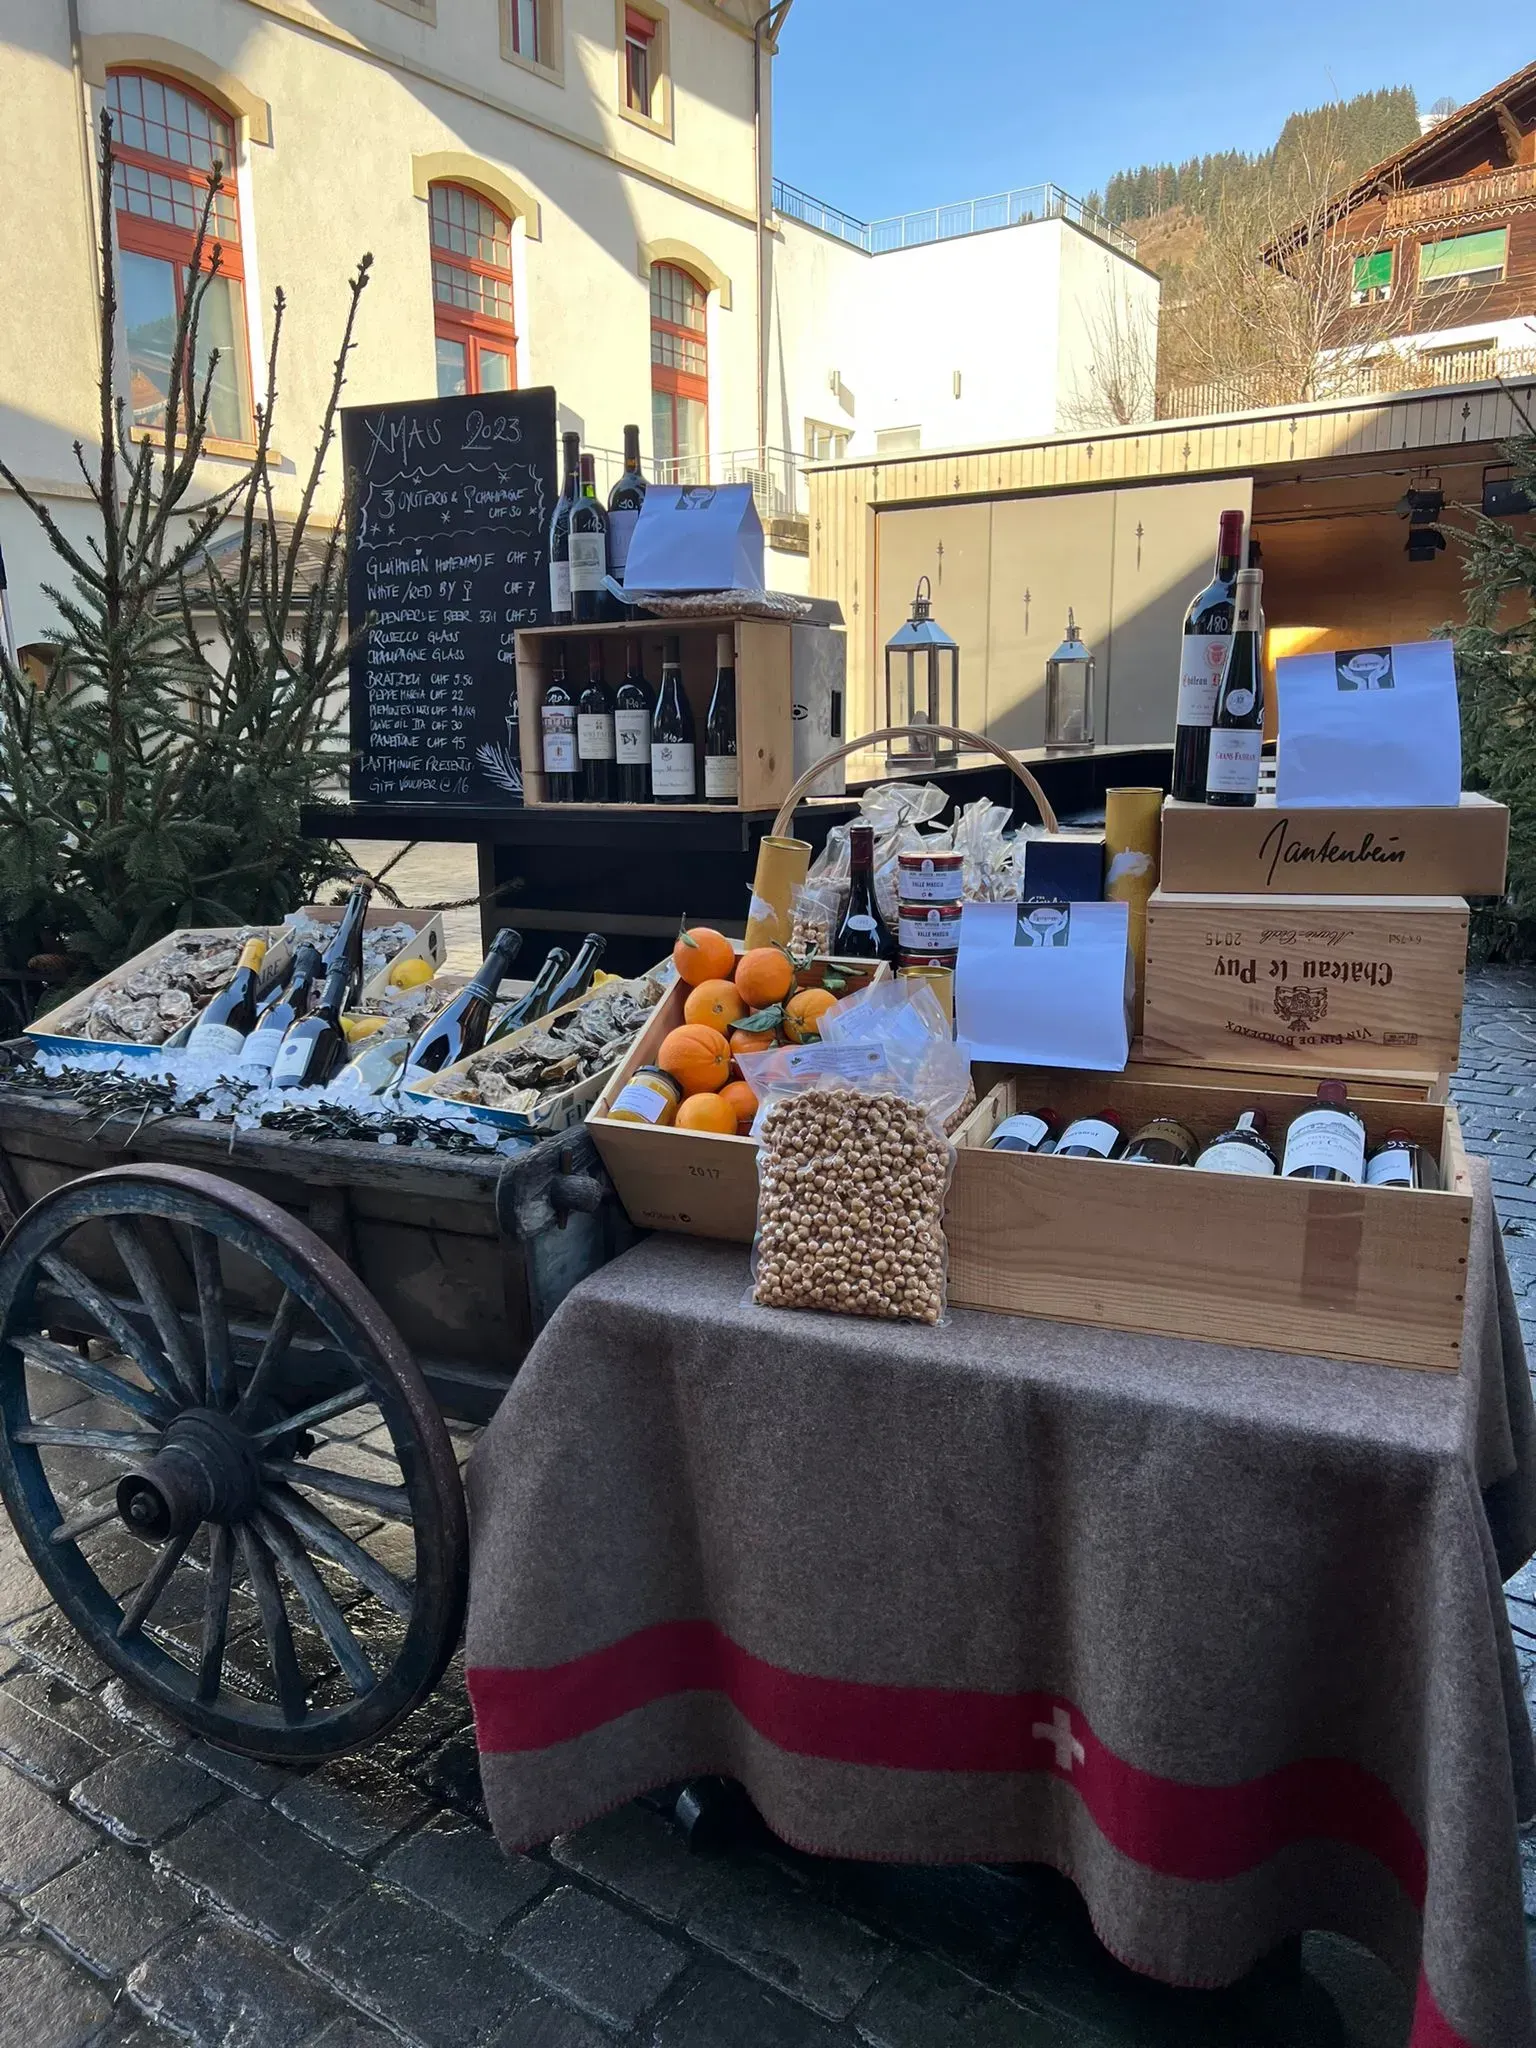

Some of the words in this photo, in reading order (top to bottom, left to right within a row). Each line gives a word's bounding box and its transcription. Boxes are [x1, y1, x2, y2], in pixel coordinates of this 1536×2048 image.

[461, 410, 522, 450] 2023
[378, 489, 397, 519] 3
[488, 507, 507, 519] CHF
[508, 508, 522, 517] 30
[507, 551, 528, 564] CHF
[534, 551, 542, 567] 7
[439, 580, 456, 600] BY
[504, 581, 523, 595] CHF
[527, 580, 536, 597] 7
[443, 609, 473, 625] BEER
[505, 609, 528, 622] CHF
[528, 609, 537, 622] 5
[1206, 614, 1228, 632] 180
[427, 631, 460, 645] GLASS
[431, 648, 465, 662] GLASS
[430, 673, 450, 686] CHF
[429, 689, 449, 702] CHF
[451, 689, 465, 701] 22
[431, 705, 448, 716] CHF
[431, 720, 450, 731] CHF
[451, 720, 463, 731] 30
[427, 736, 449, 750] CHF
[451, 737, 468, 751] 45
[1205, 931, 1243, 946] 2015
[1214, 956, 1257, 985] Puy
[1269, 958, 1289, 984] le
[1303, 960, 1393, 987] Château
[1223, 1020, 1295, 1046] BORDEAUX
[1319, 1033, 1344, 1046] FIN
[1347, 1025, 1373, 1041] VIN
[1299, 1036, 1316, 1046] DE
